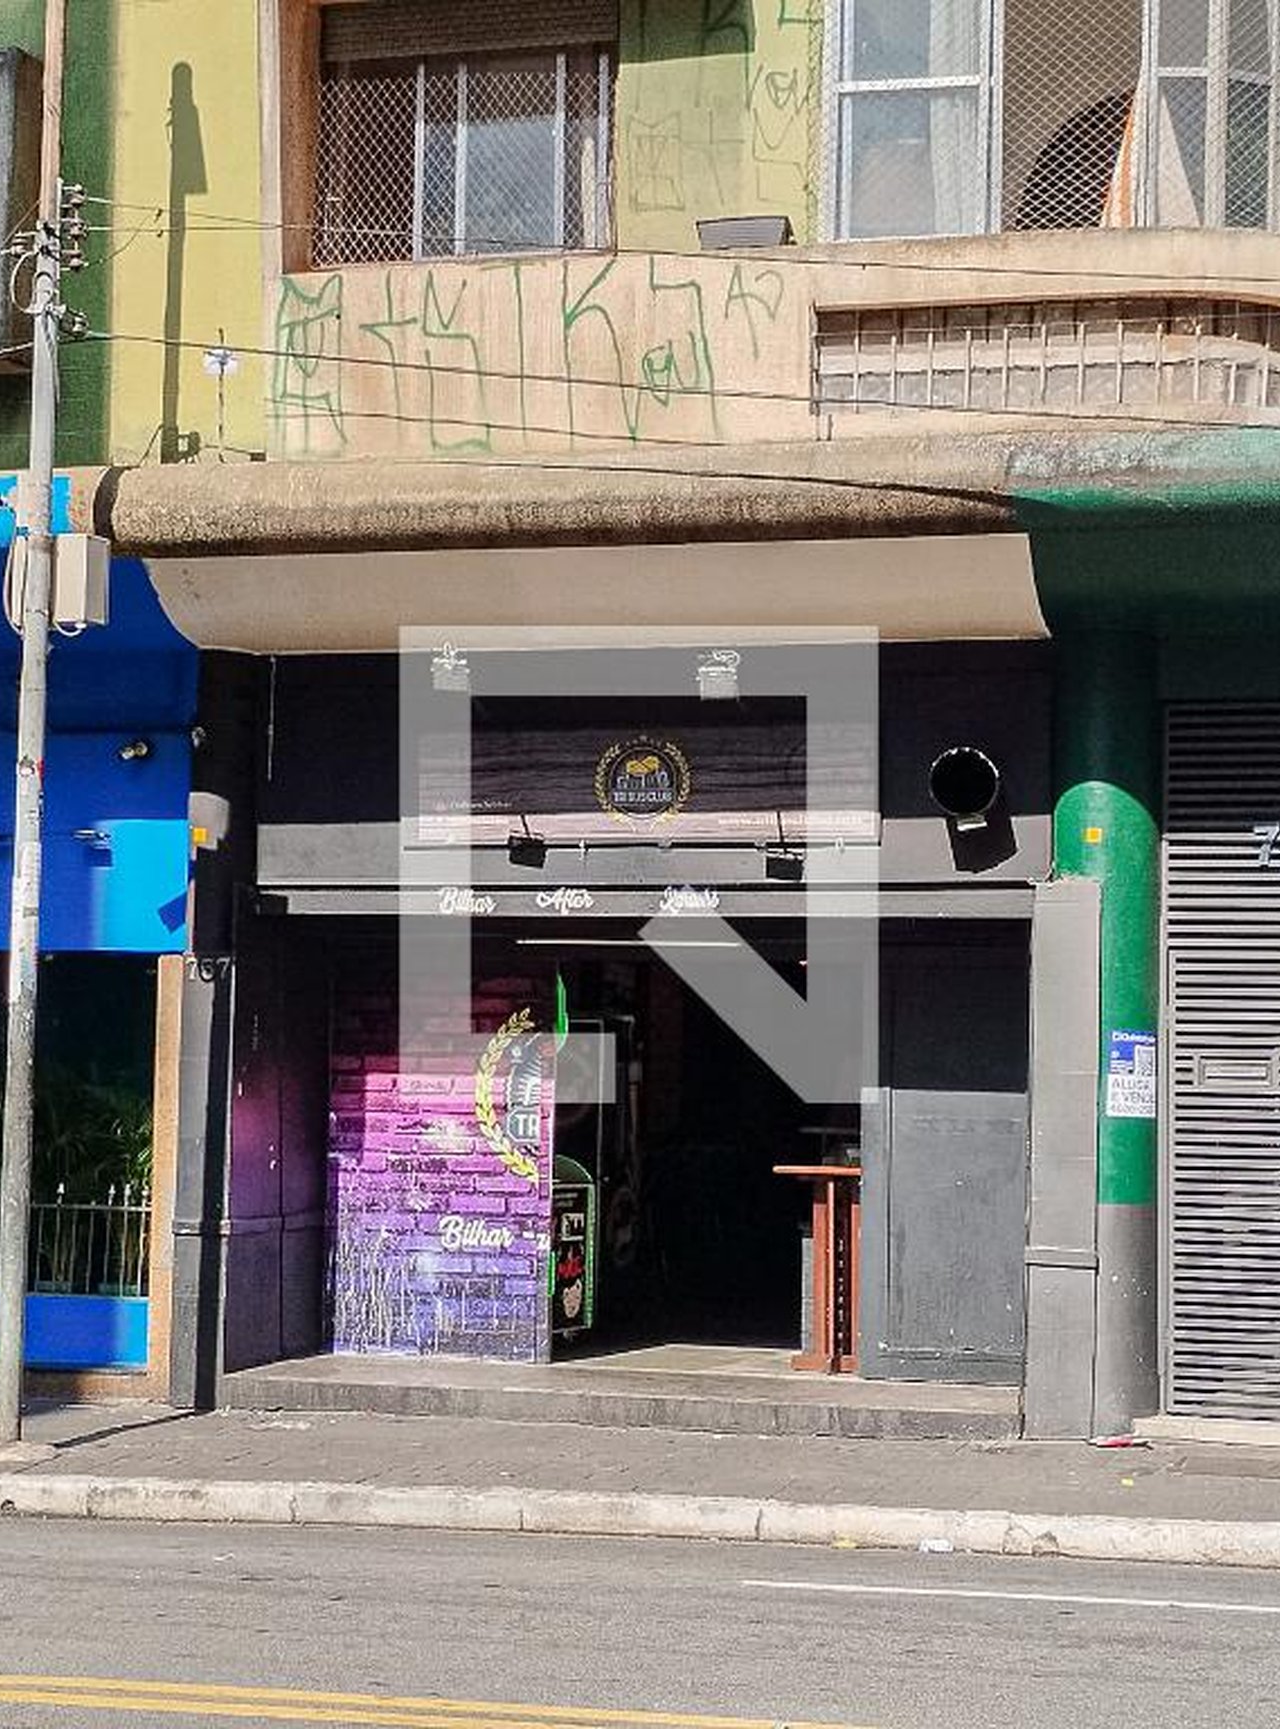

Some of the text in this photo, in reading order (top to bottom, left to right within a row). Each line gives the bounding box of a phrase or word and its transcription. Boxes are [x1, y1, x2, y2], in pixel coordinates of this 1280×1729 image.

[438, 886, 497, 914] Bilhar
[535, 886, 595, 915] After
[439, 1214, 515, 1251] Bilhar
